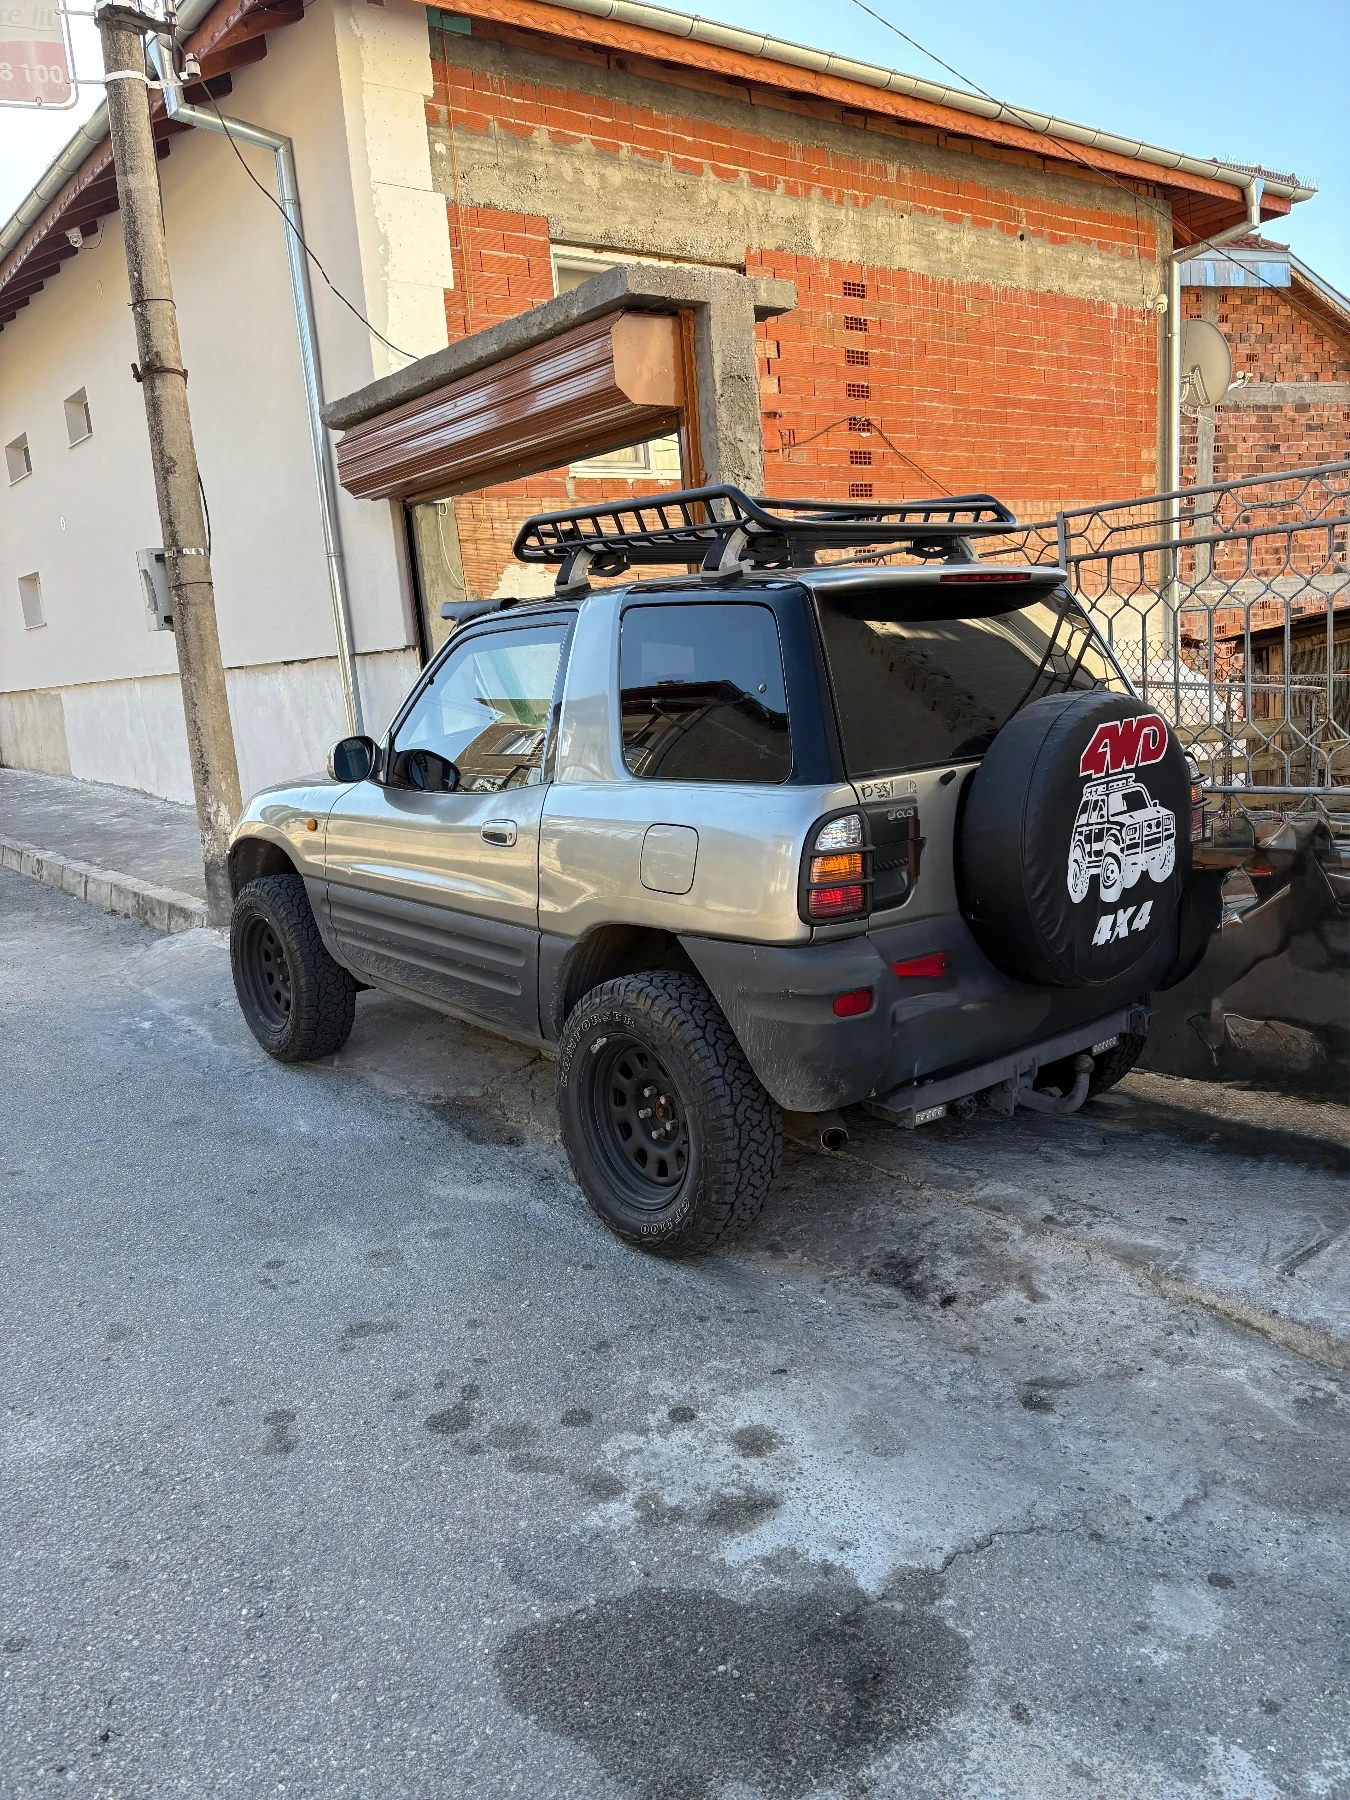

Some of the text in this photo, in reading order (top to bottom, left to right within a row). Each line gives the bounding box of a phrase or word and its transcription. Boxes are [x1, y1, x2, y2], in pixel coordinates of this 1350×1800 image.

[20, 64, 63, 83] 100
[1079, 713, 1168, 778] 4WD
[1092, 901, 1153, 946] 4X4
